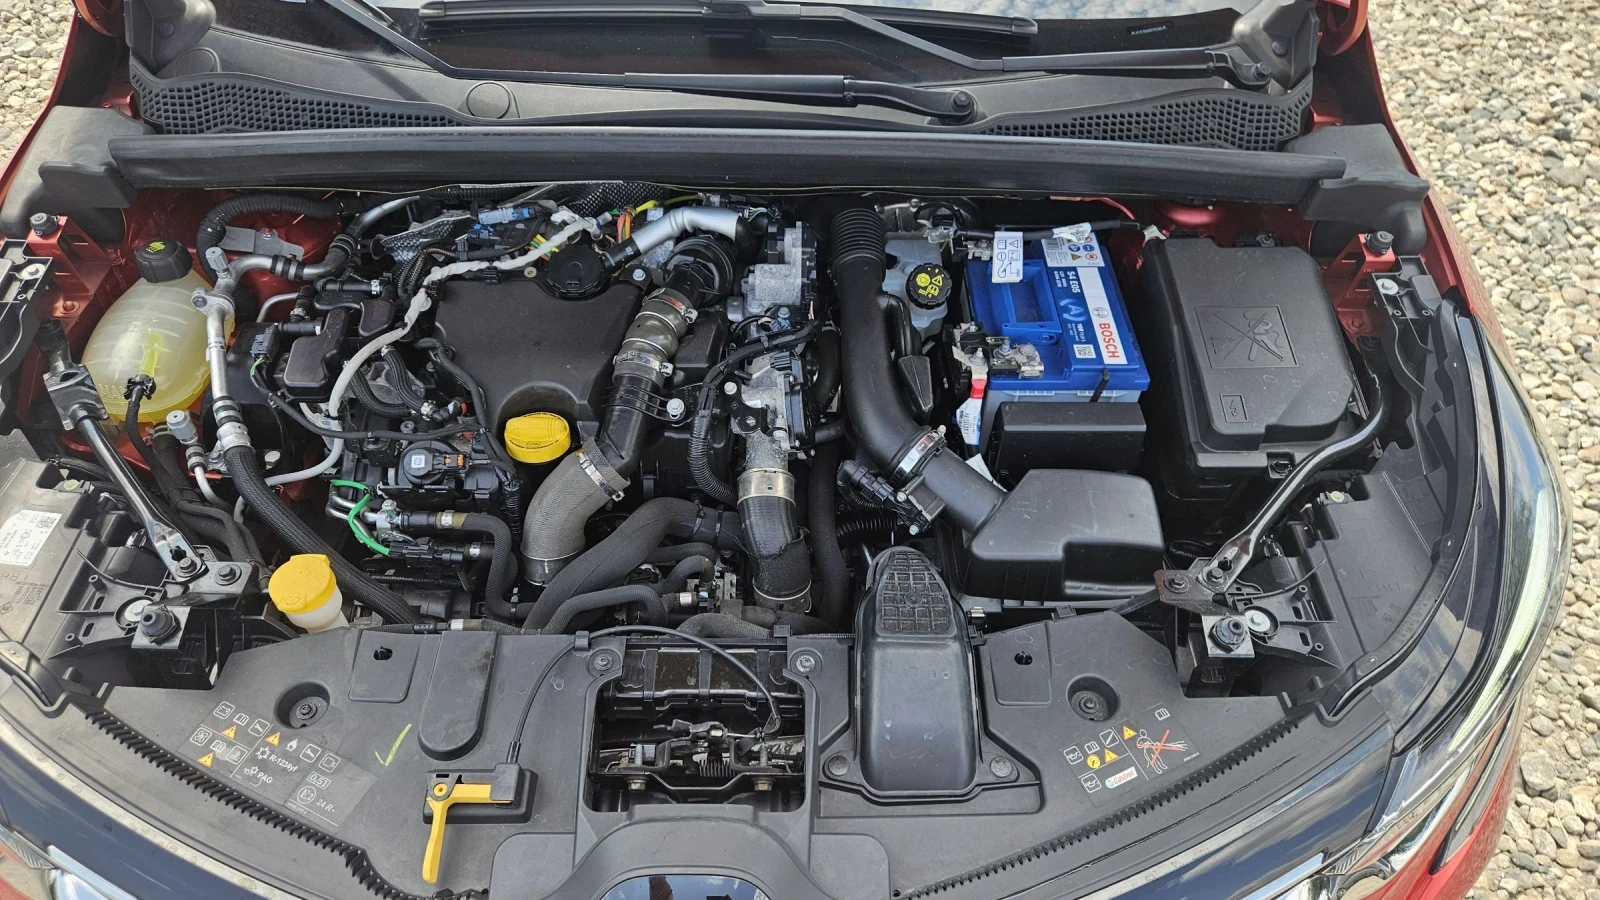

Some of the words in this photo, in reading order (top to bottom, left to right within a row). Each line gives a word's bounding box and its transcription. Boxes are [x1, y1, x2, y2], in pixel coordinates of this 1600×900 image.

[1067, 270, 1077, 280] S4
[1071, 281, 1081, 294] E05
[1098, 323, 1120, 358] BOSCH
[269, 754, 298, 771] R-1234yf
[257, 771, 273, 783] PAG
[1113, 769, 1135, 785] Castrol
